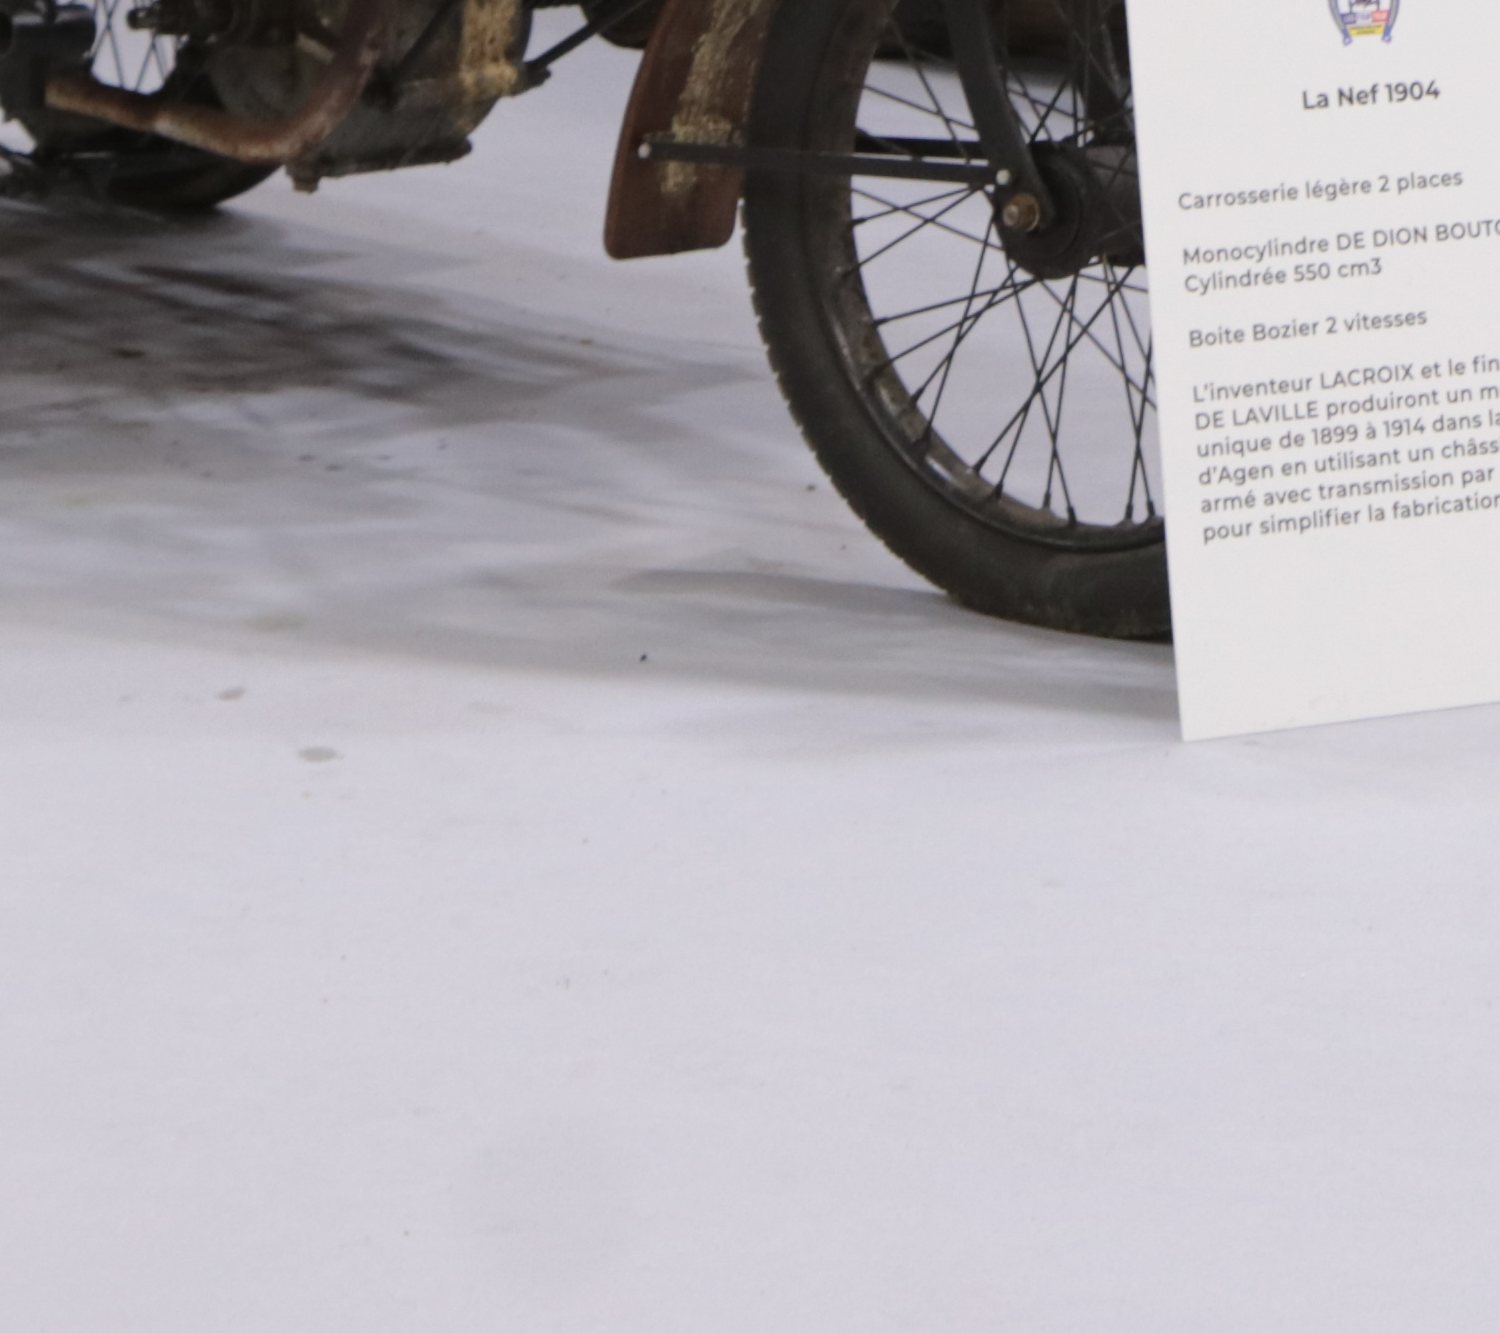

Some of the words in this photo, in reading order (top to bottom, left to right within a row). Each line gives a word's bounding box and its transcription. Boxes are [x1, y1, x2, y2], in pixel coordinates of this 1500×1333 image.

[1303, 91, 1329, 110] La
[1338, 83, 1378, 107] Nef
[1385, 80, 1440, 102] 1904
[1179, 183, 1298, 210] Carrosserie
[1306, 180, 1371, 201] légère
[1379, 175, 1389, 192] 2
[1397, 173, 1463, 194] places
[1183, 237, 1328, 264] Monocylindre
[1337, 232, 1365, 250] DE
[1373, 227, 1427, 247] DION
[1185, 269, 1286, 295] Cylindrée
[1295, 263, 1330, 282] 550
[1338, 258, 1381, 277] cm3
[1189, 327, 1244, 347] Boite
[1253, 322, 1318, 341] Bozier
[1326, 317, 1337, 334] 2
[1344, 312, 1427, 331] vitesses
[1193, 378, 1312, 402] L'inventeur
[1321, 364, 1413, 389] LACROIX
[1421, 363, 1441, 378] et
[1449, 359, 1465, 375] le
[1196, 411, 1224, 430] DE
[1233, 401, 1318, 426] LAVILLE
[1327, 390, 1438, 419] produiront
[1447, 389, 1472, 403] un
[1198, 438, 1271, 457] unique
[1279, 431, 1304, 449] de
[1312, 425, 1358, 444] 1899
[1366, 426, 1376, 439] à
[1384, 419, 1425, 437] 1914
[1433, 415, 1482, 432] dans
[1199, 465, 1273, 485] d'Agen
[1281, 461, 1306, 476] en
[1315, 449, 1400, 472] utilisant
[1408, 448, 1433, 462] un
[1201, 491, 1255, 513] armé
[1264, 489, 1310, 505] avec
[1319, 473, 1453, 499] transmission
[1462, 468, 1494, 487] par
[1204, 523, 1252, 544] pour
[1260, 509, 1360, 534] simplifier
[1369, 505, 1385, 521] la
